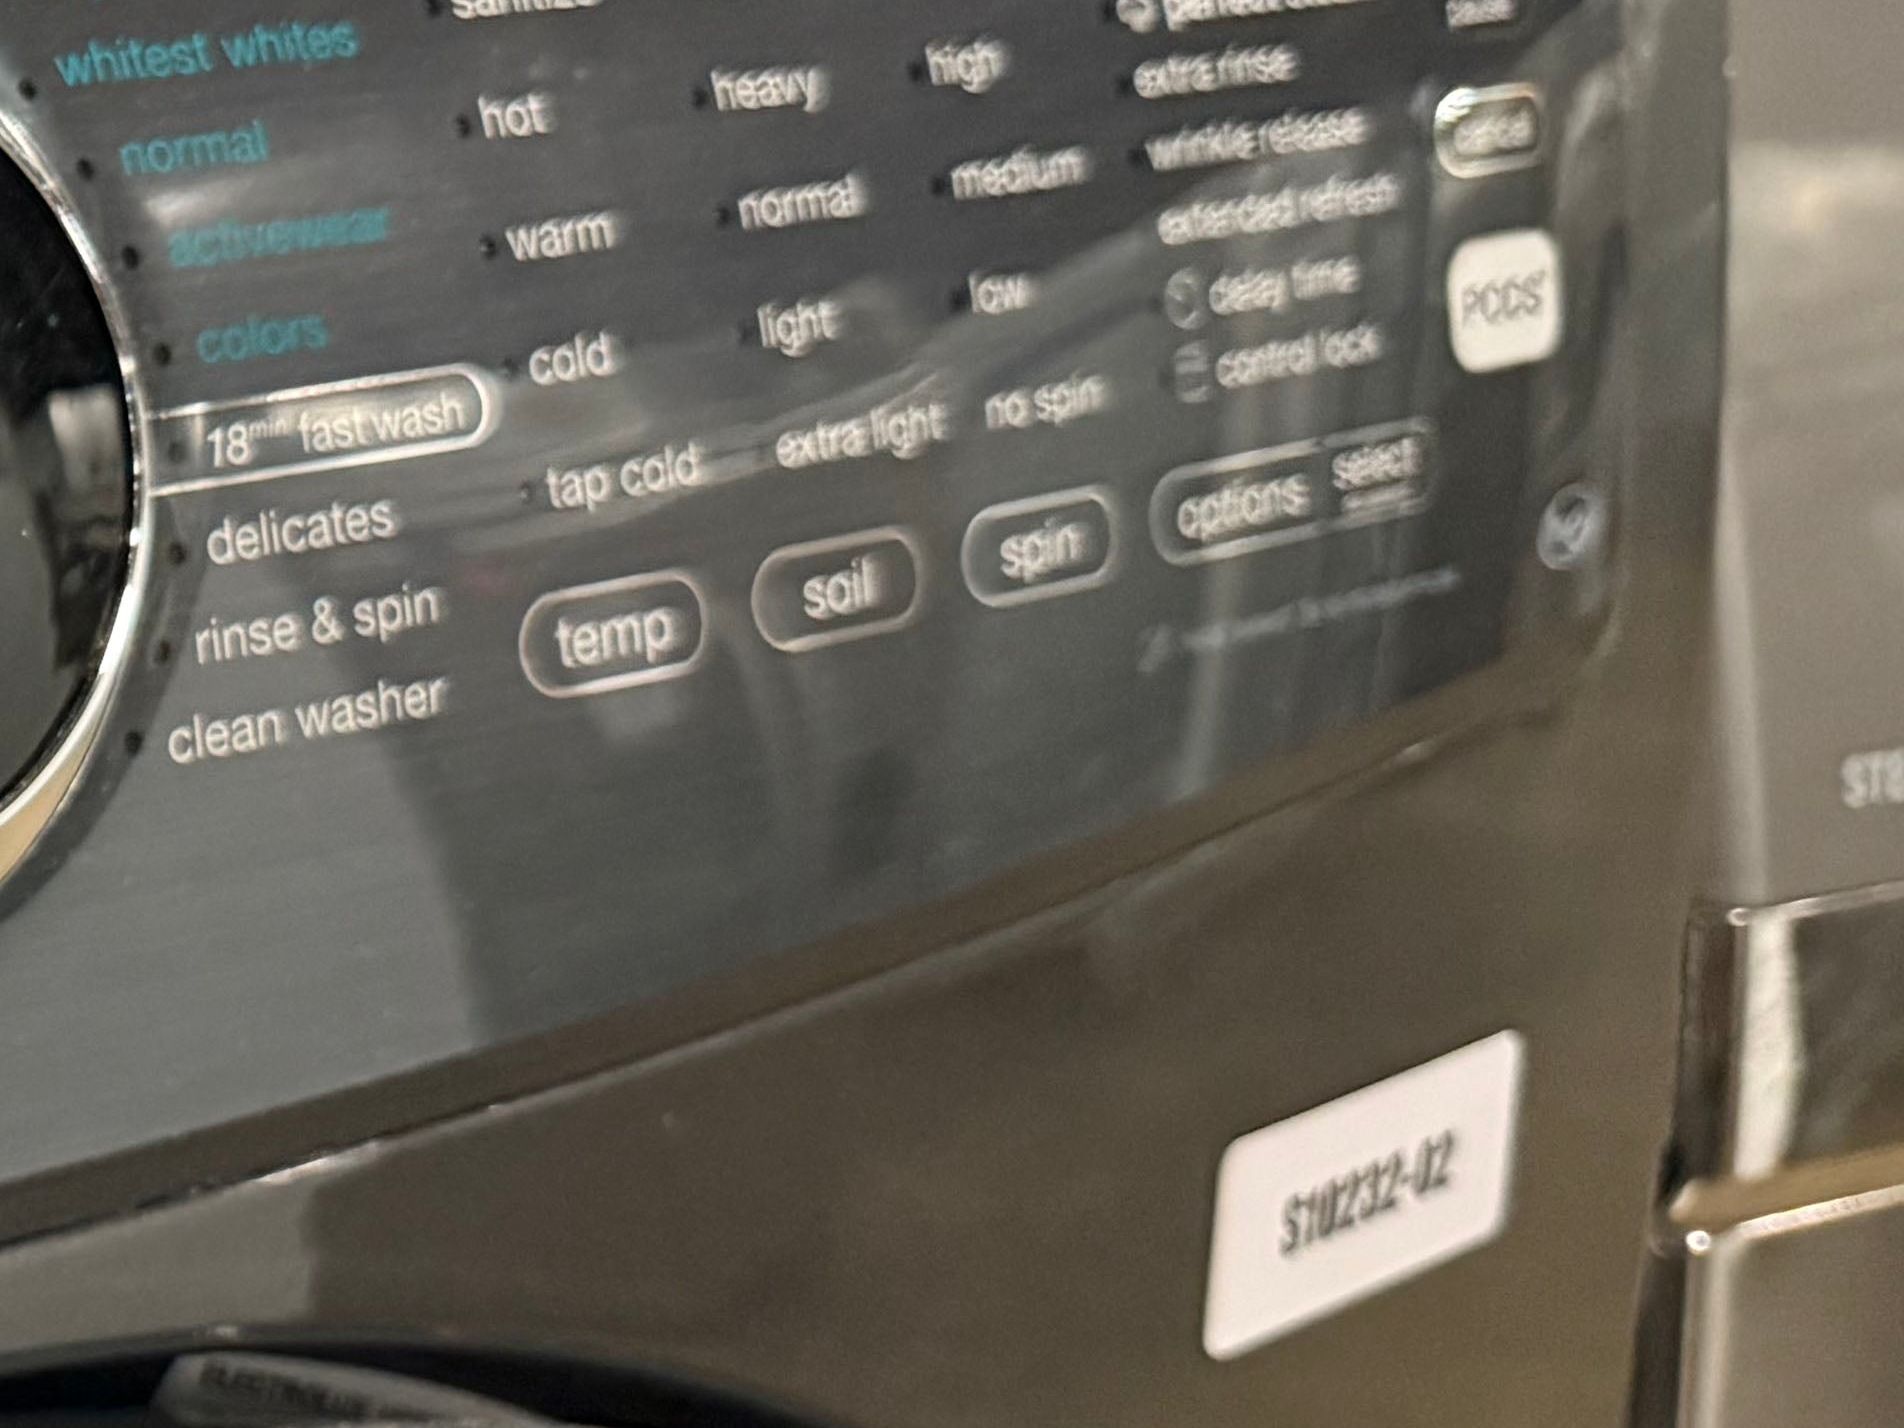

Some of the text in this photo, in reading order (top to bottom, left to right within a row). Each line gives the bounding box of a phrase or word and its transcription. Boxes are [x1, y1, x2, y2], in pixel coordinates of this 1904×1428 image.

[54, 20, 362, 87] whitest whites
[925, 37, 1013, 94] high
[478, 91, 554, 139] hot
[711, 66, 831, 113] heavy
[118, 119, 270, 175] normal
[950, 144, 1093, 200] medium
[737, 170, 868, 230] normal
[505, 209, 620, 262] warm
[969, 272, 1038, 314] low
[196, 314, 329, 363] colors
[529, 329, 620, 385] cold
[757, 297, 845, 357] light
[297, 410, 371, 452] fast
[369, 392, 466, 441] wash
[985, 373, 1109, 429] no spin
[776, 402, 950, 468] extra light
[546, 442, 703, 512] tap cold
[207, 499, 400, 565] delicates
[1178, 475, 1312, 544] options
[1000, 516, 1091, 583] spin
[802, 553, 885, 621] soil
[195, 582, 445, 665] rinse & spin
[556, 605, 682, 668] temp
[168, 677, 451, 764] clean washer
